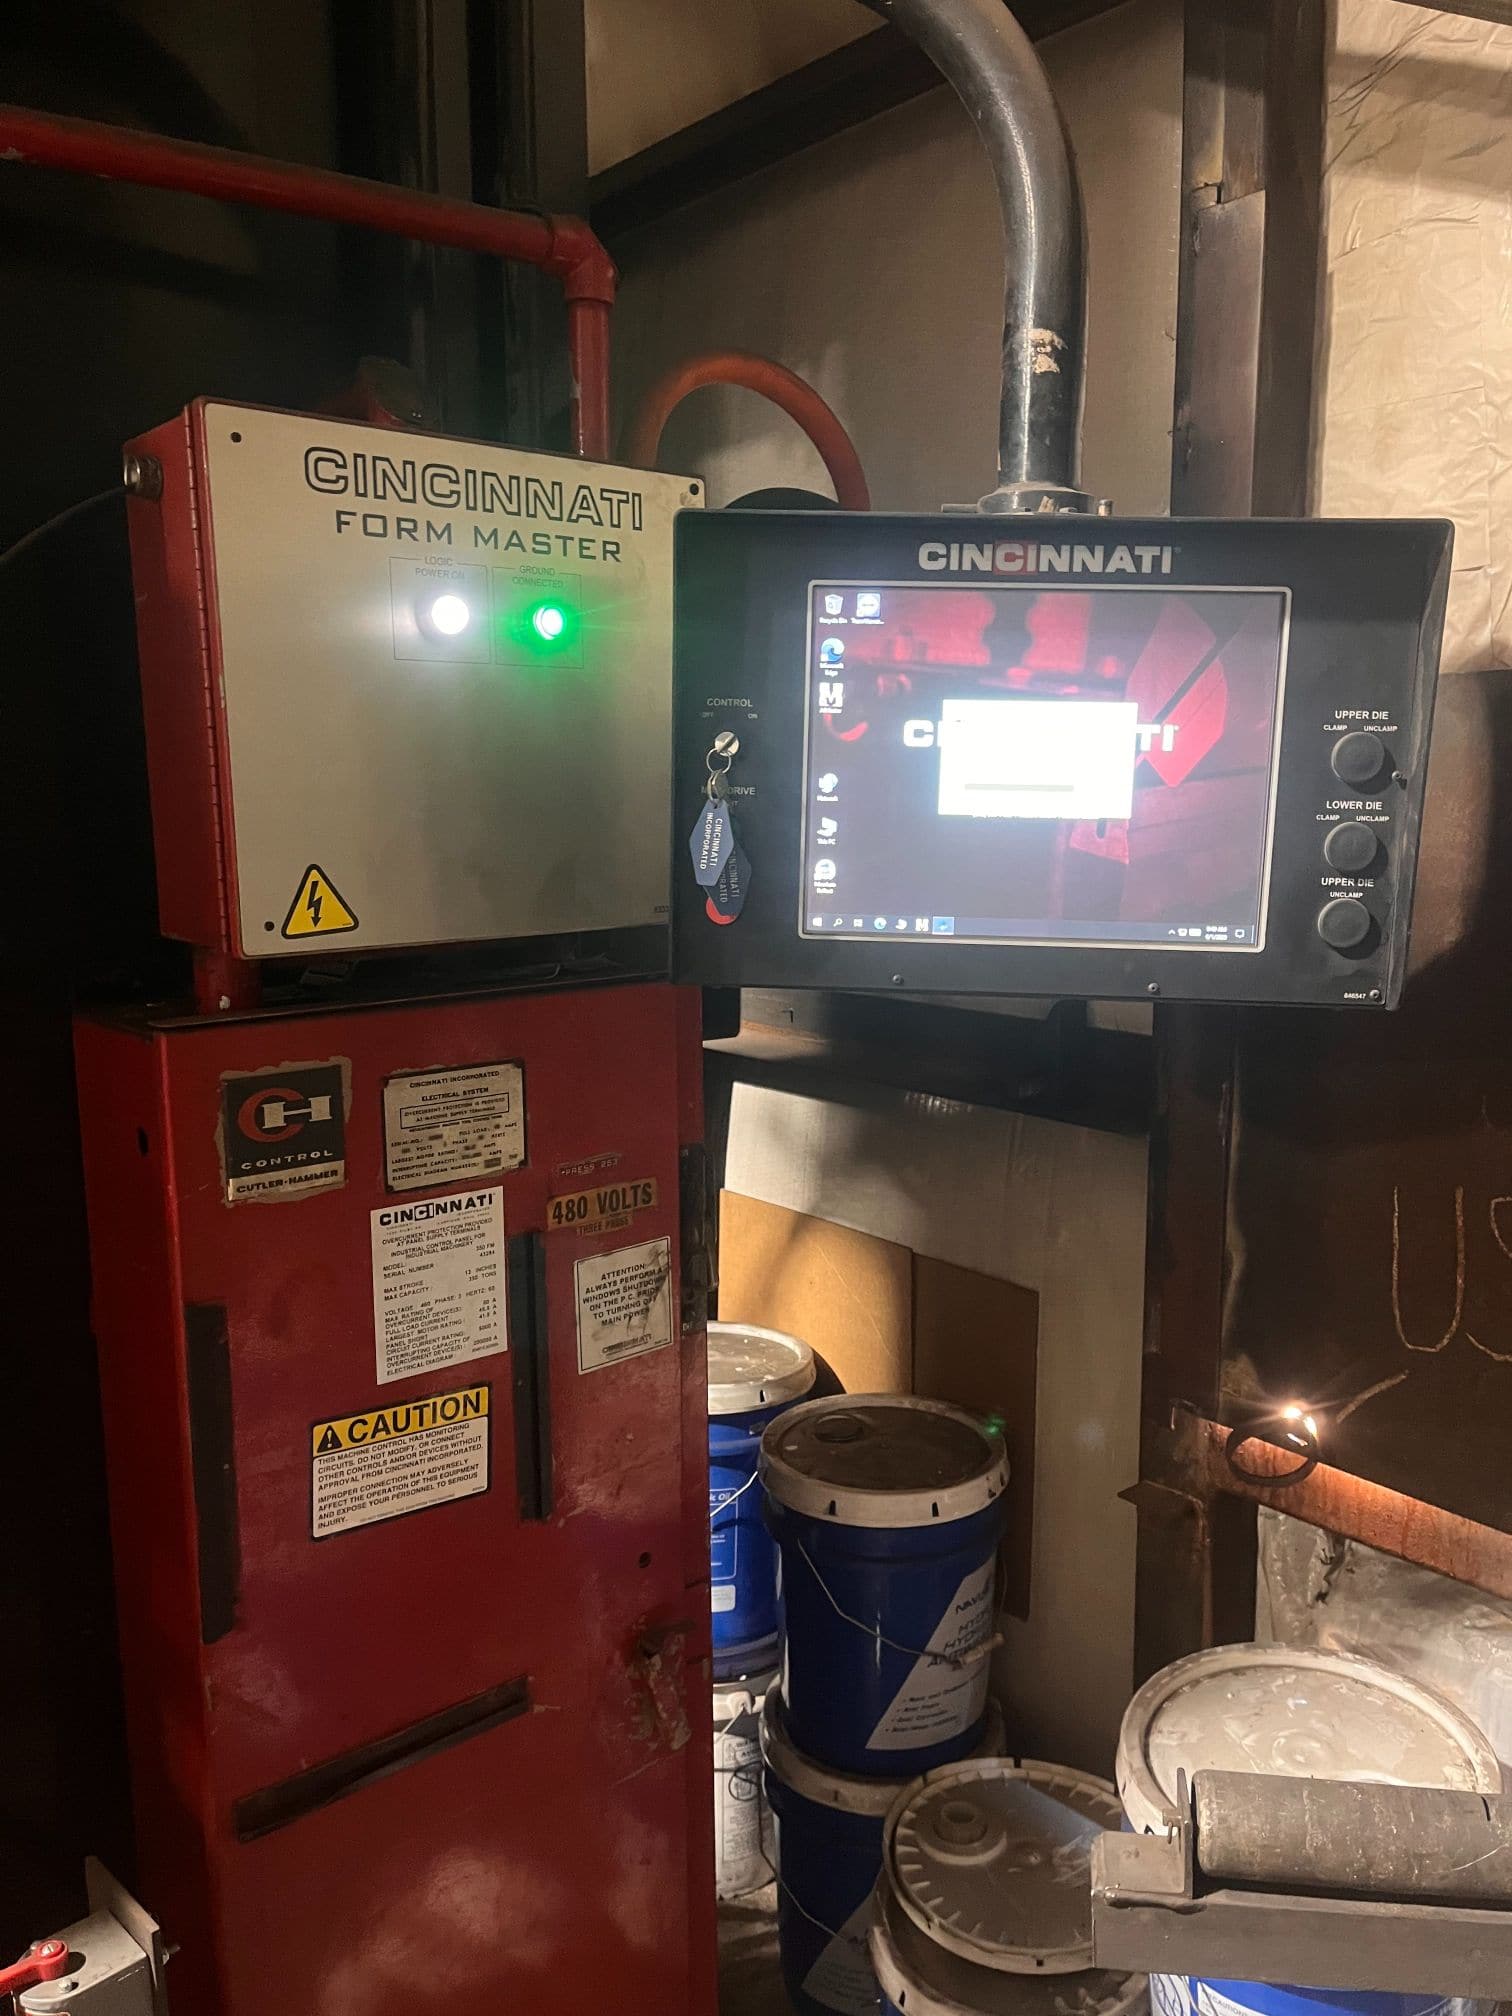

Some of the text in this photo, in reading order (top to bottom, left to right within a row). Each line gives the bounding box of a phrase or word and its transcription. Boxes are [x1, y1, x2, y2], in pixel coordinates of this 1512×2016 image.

[305, 446, 643, 530] CINCINNATI
[336, 510, 622, 562] FORM MASTER
[424, 556, 453, 567] LOGIC
[918, 541, 1173, 574] CINCINNATI
[415, 567, 465, 580] POWER ON
[519, 565, 555, 576] GROUND
[512, 576, 563, 588] CONNECTED
[706, 698, 753, 708] CONTROL
[1335, 710, 1389, 720] UPPER DIE
[1326, 800, 1382, 810] LOWER DIE
[700, 812, 714, 870] INCORPORATED
[710, 818, 723, 866] CINCINNATI
[1321, 877, 1375, 887] UPPER DIE
[409, 1070, 499, 1088] CINCINNATI INCORPORATED
[421, 1091, 459, 1101] ELECTRICAL
[240, 1150, 334, 1170] CONTROL
[380, 1193, 492, 1226] CINCINNATI
[552, 1182, 652, 1225] 480 VOLTS
[382, 1231, 425, 1244] OVERCURRENT
[427, 1223, 462, 1235] PROTECTION
[464, 1217, 492, 1227] PROVIDED
[405, 1236, 424, 1245] PANEL
[426, 1231, 447, 1240] SUPPLY
[450, 1225, 480, 1236] TERMINALS
[391, 1245, 423, 1257] INDUSTRIAL
[425, 1238, 453, 1249] CONTROL
[454, 1235, 472, 1243] PANEL
[405, 1240, 472, 1259] INDUSTRIAL MACHINERY
[383, 1269, 405, 1279] SERIAL
[482, 1270, 496, 1278] TONS
[585, 1279, 617, 1294] ALWAYS
[619, 1268, 655, 1284] PERFORM
[601, 1262, 644, 1281] ATTENTION
[383, 1285, 397, 1293] MAX
[399, 1279, 423, 1290] STROKE
[583, 1287, 620, 1304] WINDOWS
[589, 1302, 600, 1311] ON
[603, 1297, 617, 1307] THE
[593, 1299, 640, 1320] TO TURNING
[384, 1315, 398, 1323] MAX
[401, 1309, 424, 1319] RATING
[385, 1313, 430, 1329] OVERCURRENT
[385, 1327, 400, 1335] FULL
[402, 1322, 418, 1331] LOAD
[420, 1315, 448, 1327] CURRENT
[601, 1306, 649, 1326] MAIN POWER
[385, 1330, 413, 1342] LARGEST
[417, 1324, 438, 1334] MOTOR
[385, 1334, 427, 1349] PANEL SHORT
[386, 1344, 410, 1355] CIRCUIT
[411, 1336, 440, 1348] CURRENT
[386, 1346, 430, 1362] INTERRUPTING
[431, 1338, 460, 1350] CAPACITY
[386, 1351, 431, 1368] OVERCURRENT
[386, 1361, 424, 1375] ELECTRICAL
[347, 1391, 480, 1444] CAUTION
[318, 1422, 469, 1465] THIS MACHINE CONTROL HAS MONITORING
[318, 1458, 355, 1474] CIRCUITS.
[357, 1455, 368, 1464] DO
[370, 1451, 384, 1460] NOT
[418, 1440, 428, 1448] OR
[431, 1431, 463, 1445] CONNECT
[318, 1435, 480, 1482] OTHER CONTROLS AND/OR DEVICES WITHOUT
[318, 1442, 483, 1491] APPROVAL FROM CINCINNATI INCORPORATED.
[318, 1458, 468, 1503] IMPROPER CONNECTION MAY ADVERSELY
[318, 1463, 478, 1511] AFFECT THE OPERATION OF THIS EQUIPMENT
[318, 1510, 334, 1520] AND
[336, 1501, 366, 1515] EXPOSE
[369, 1495, 389, 1506] YOUR
[391, 1483, 434, 1500] PERSONNEL
[436, 1480, 445, 1488] TO
[448, 1471, 477, 1485] SERIOUS
[318, 1515, 347, 1529] INJURY.
